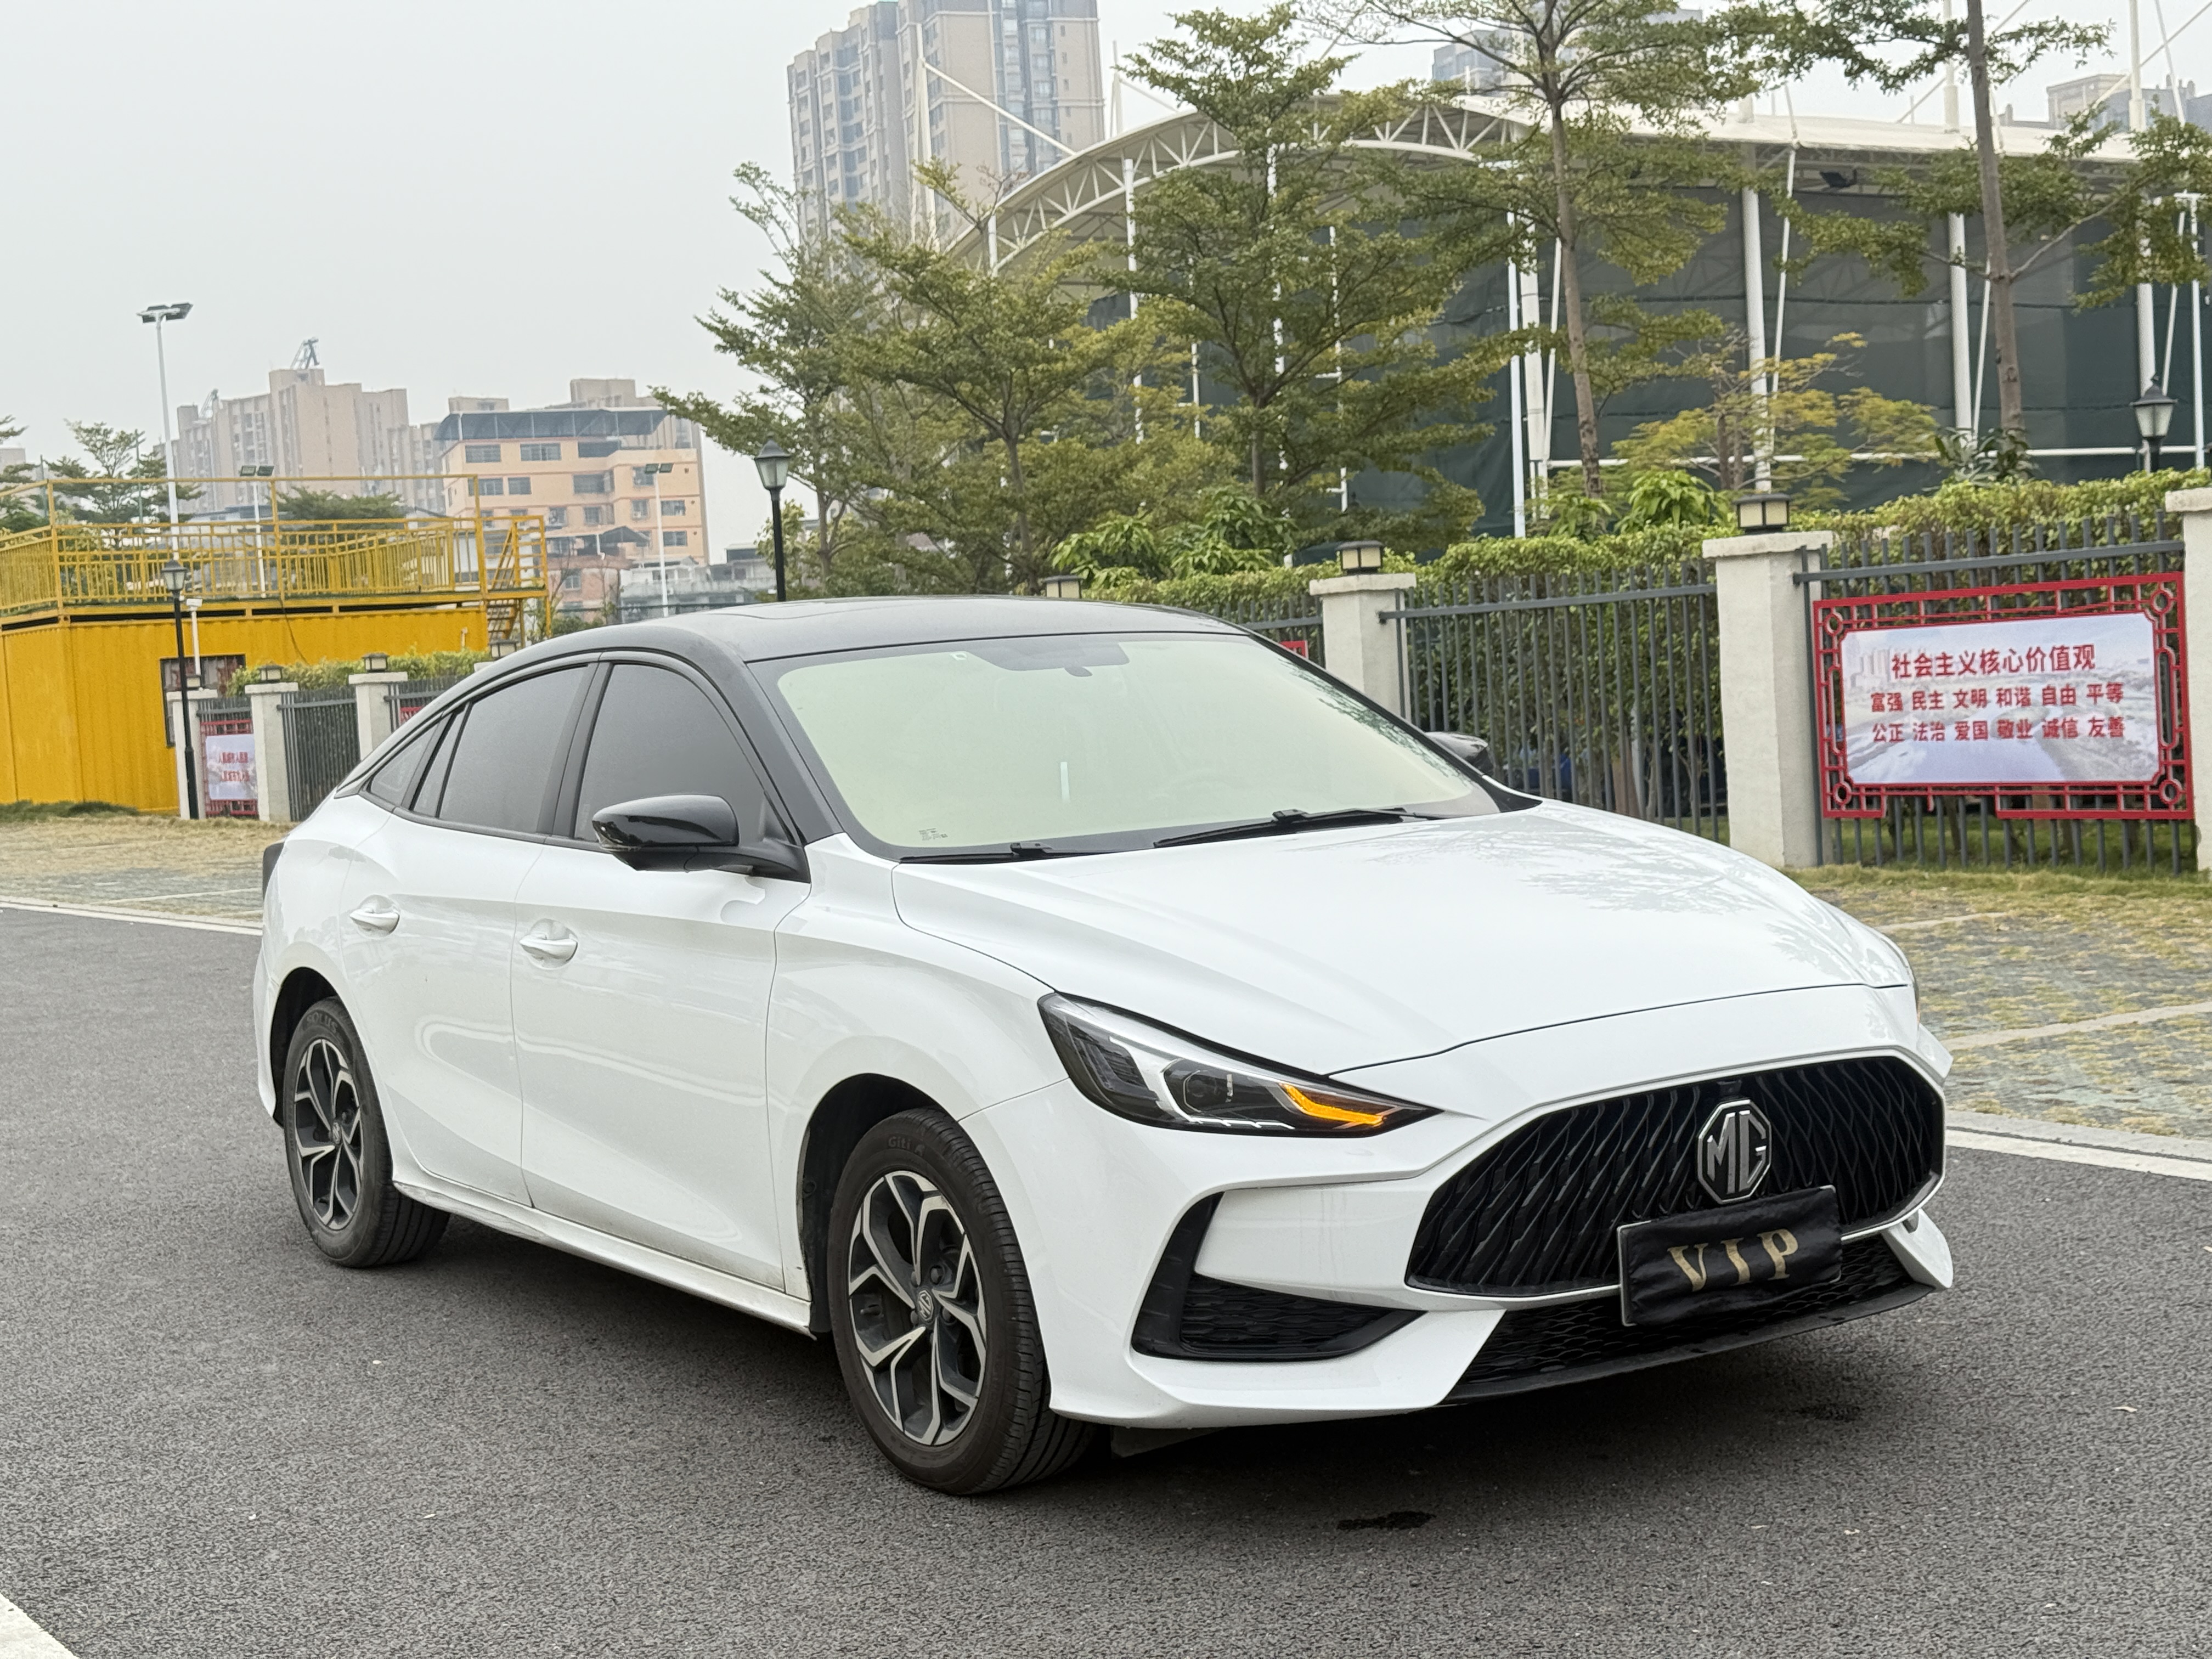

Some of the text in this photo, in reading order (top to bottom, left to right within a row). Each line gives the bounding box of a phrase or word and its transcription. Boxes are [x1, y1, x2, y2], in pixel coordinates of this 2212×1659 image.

[1892, 644, 2095, 679] 社会主义核心价值观
[1871, 682, 2124, 712] 富强 民主 文明 和谐 自由 平等
[1872, 715, 2125, 742] 公正 法治 爱国 敬业 诚信 友善
[888, 1136, 911, 1149] Giti
[1707, 1110, 1767, 1194] MG
[1667, 1228, 1799, 1292] VIP
